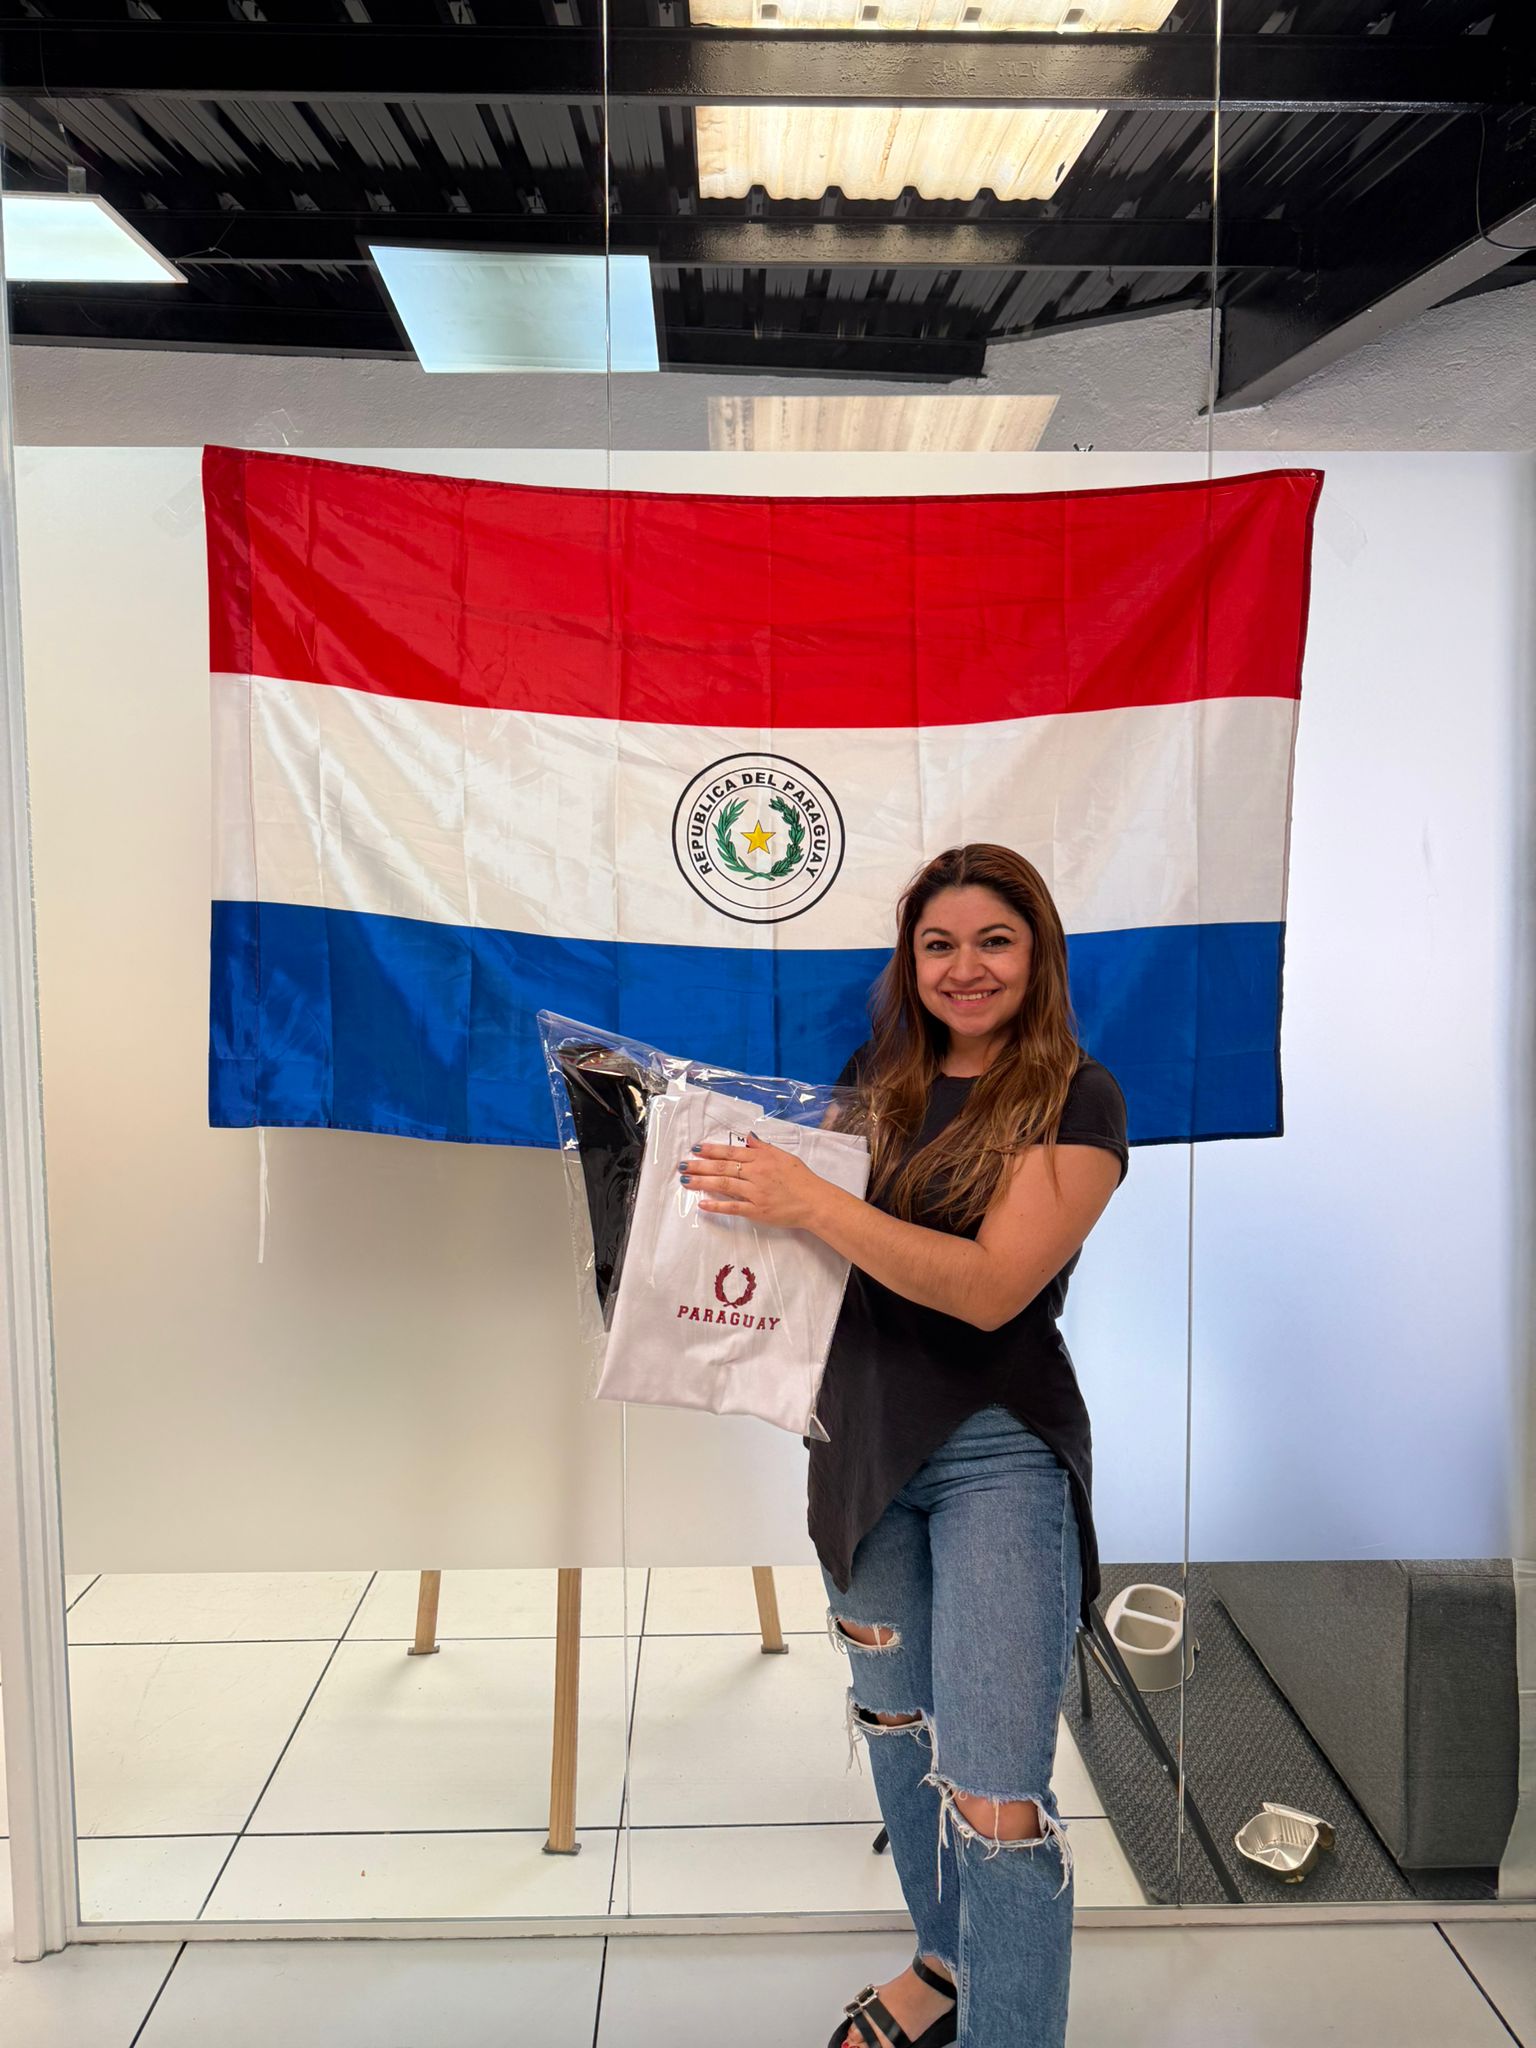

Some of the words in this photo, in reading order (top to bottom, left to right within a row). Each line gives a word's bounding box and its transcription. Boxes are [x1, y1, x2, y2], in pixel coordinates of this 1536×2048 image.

[691, 778, 738, 876] REPUBLICA
[741, 772, 777, 787] DEL
[782, 780, 826, 879] PARAGUAY
[676, 1305, 781, 1331] PARAGUAY
